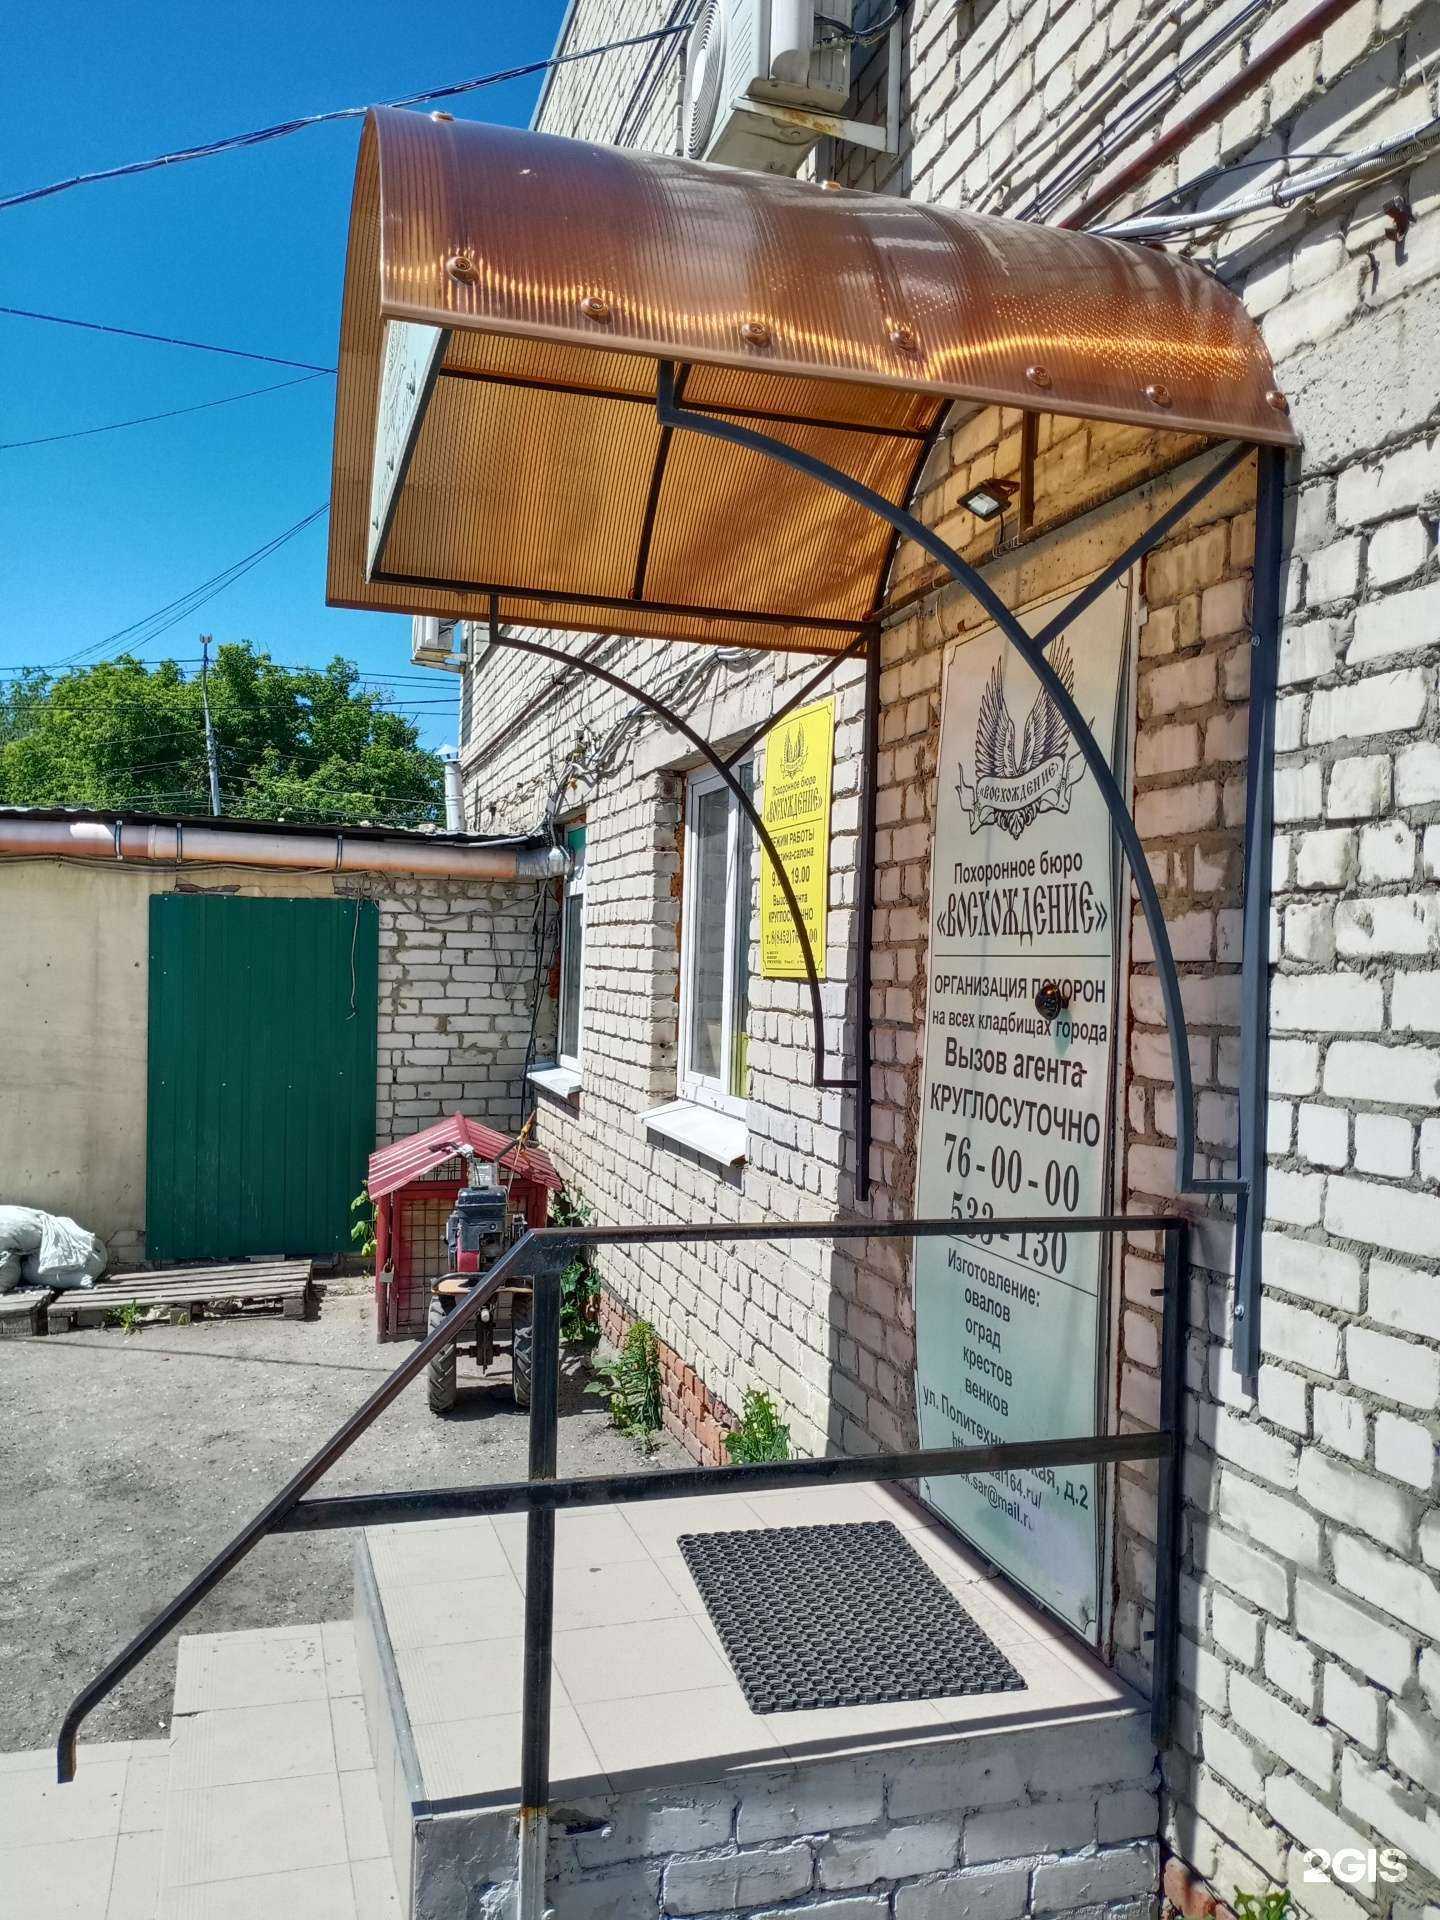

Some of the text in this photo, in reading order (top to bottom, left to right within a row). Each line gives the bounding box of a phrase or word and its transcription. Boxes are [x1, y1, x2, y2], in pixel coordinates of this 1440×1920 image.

[771, 828, 815, 848] ЕЖИМ РАБОТЫ
[791, 866, 810, 884] 19.00
[954, 850, 1083, 887] Похоронное бюро
[773, 894, 789, 906] Вызо
[936, 880, 1108, 947] «ВОСХОЖДЕНИЕ»
[934, 974, 1027, 1002] ОРГАНИЗАЦИЯ
[932, 1010, 1107, 1045] на всех кладбищах города
[945, 1036, 1084, 1088] Вызов агента
[930, 1082, 1101, 1147] КРУГЛОСУТОЧНО
[948, 1248, 1040, 1307] Изготовление:
[964, 1288, 1011, 1323] овалов
[965, 1317, 1001, 1353] оград
[963, 1346, 1013, 1387] крестов
[965, 1378, 1009, 1417] венков
[923, 1385, 1089, 1510] ул. Политехная, д.2
